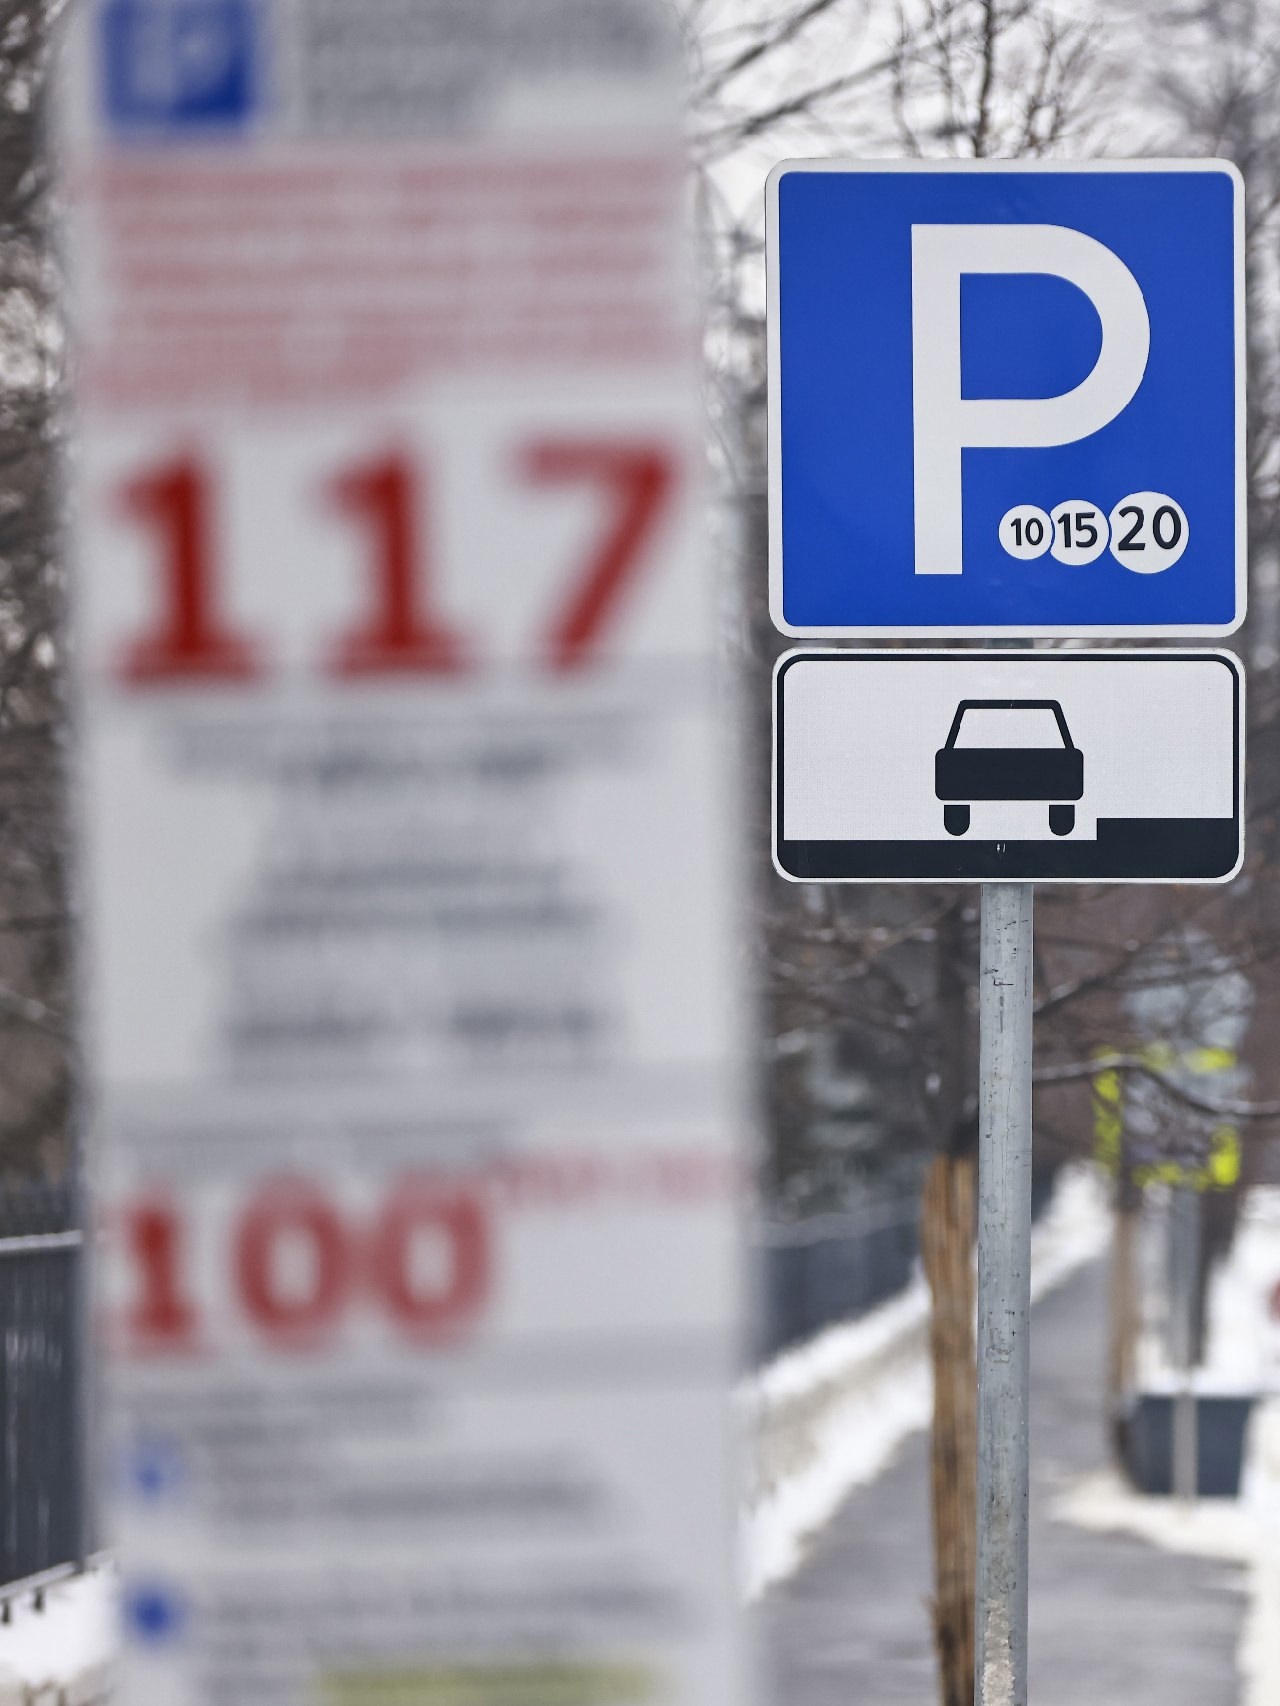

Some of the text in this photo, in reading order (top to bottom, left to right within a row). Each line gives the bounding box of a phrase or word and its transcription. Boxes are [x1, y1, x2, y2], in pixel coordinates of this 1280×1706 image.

[911, 224, 1151, 575] P
[112, 438, 682, 690] 117
[1010, 505, 1182, 550] 10 15 20
[112, 1165, 498, 1354] 100
